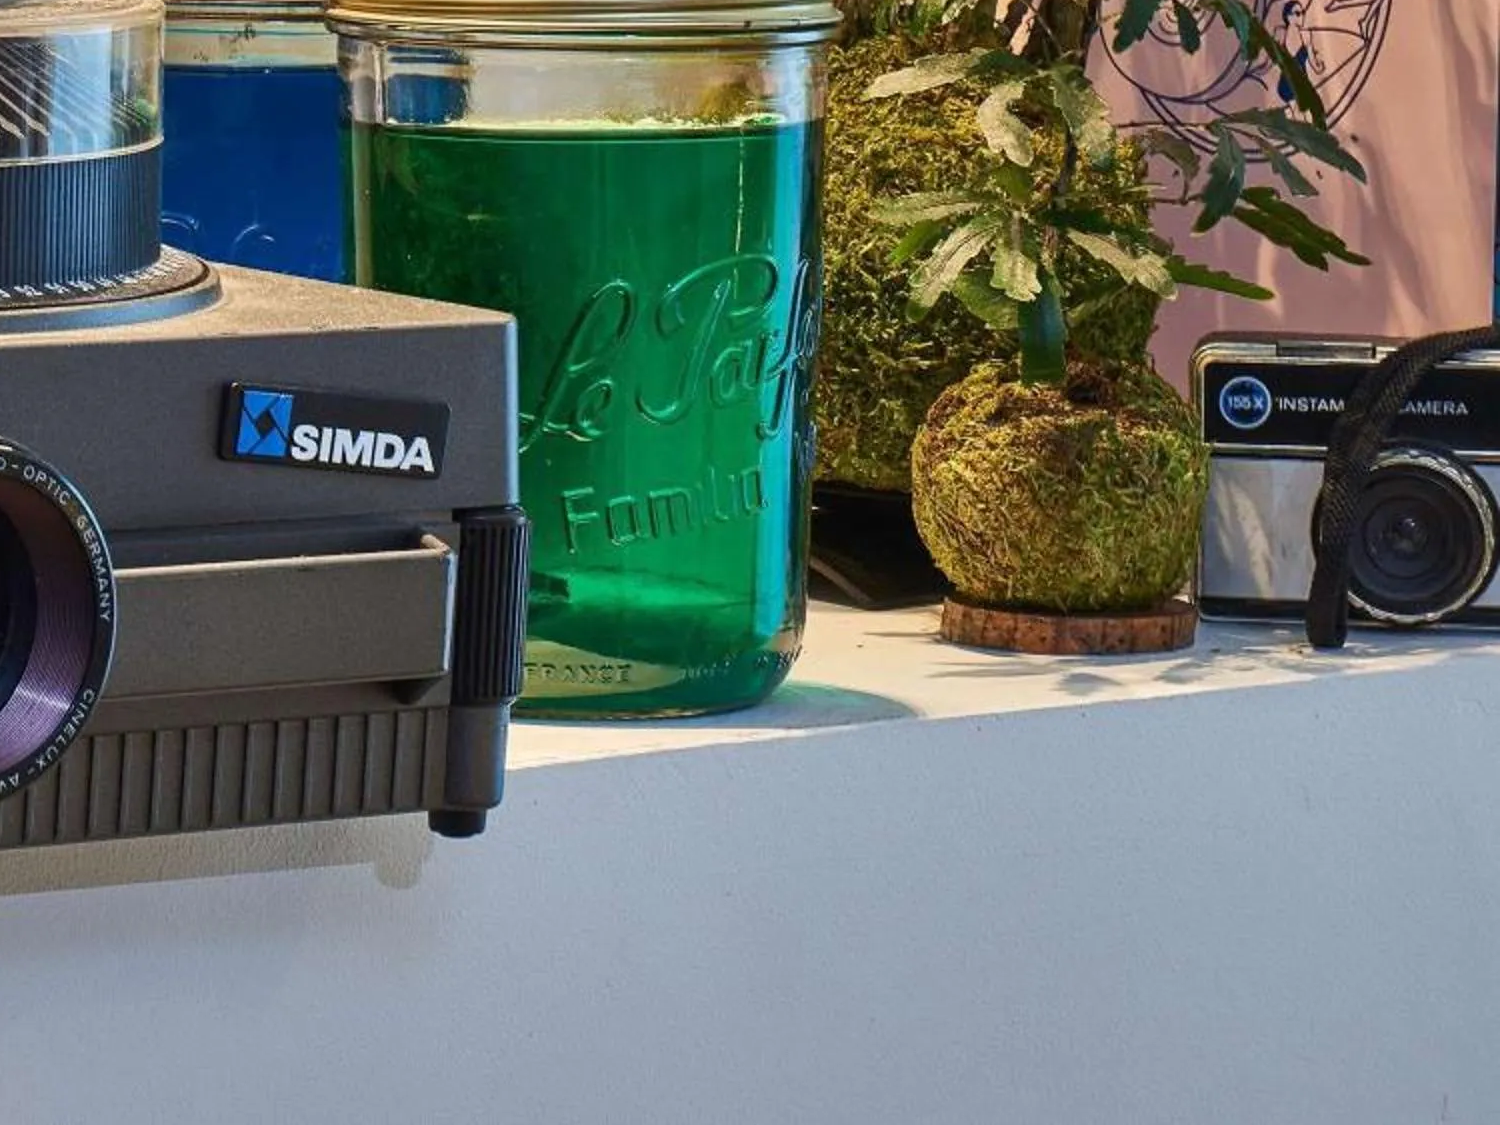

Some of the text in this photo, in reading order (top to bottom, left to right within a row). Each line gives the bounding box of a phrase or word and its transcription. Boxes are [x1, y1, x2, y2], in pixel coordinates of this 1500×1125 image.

[634, 252, 823, 443] Parf
[1398, 399, 1469, 416] AMERA
[290, 424, 435, 473] SIMDA
[77, 514, 112, 624] GERMANY
